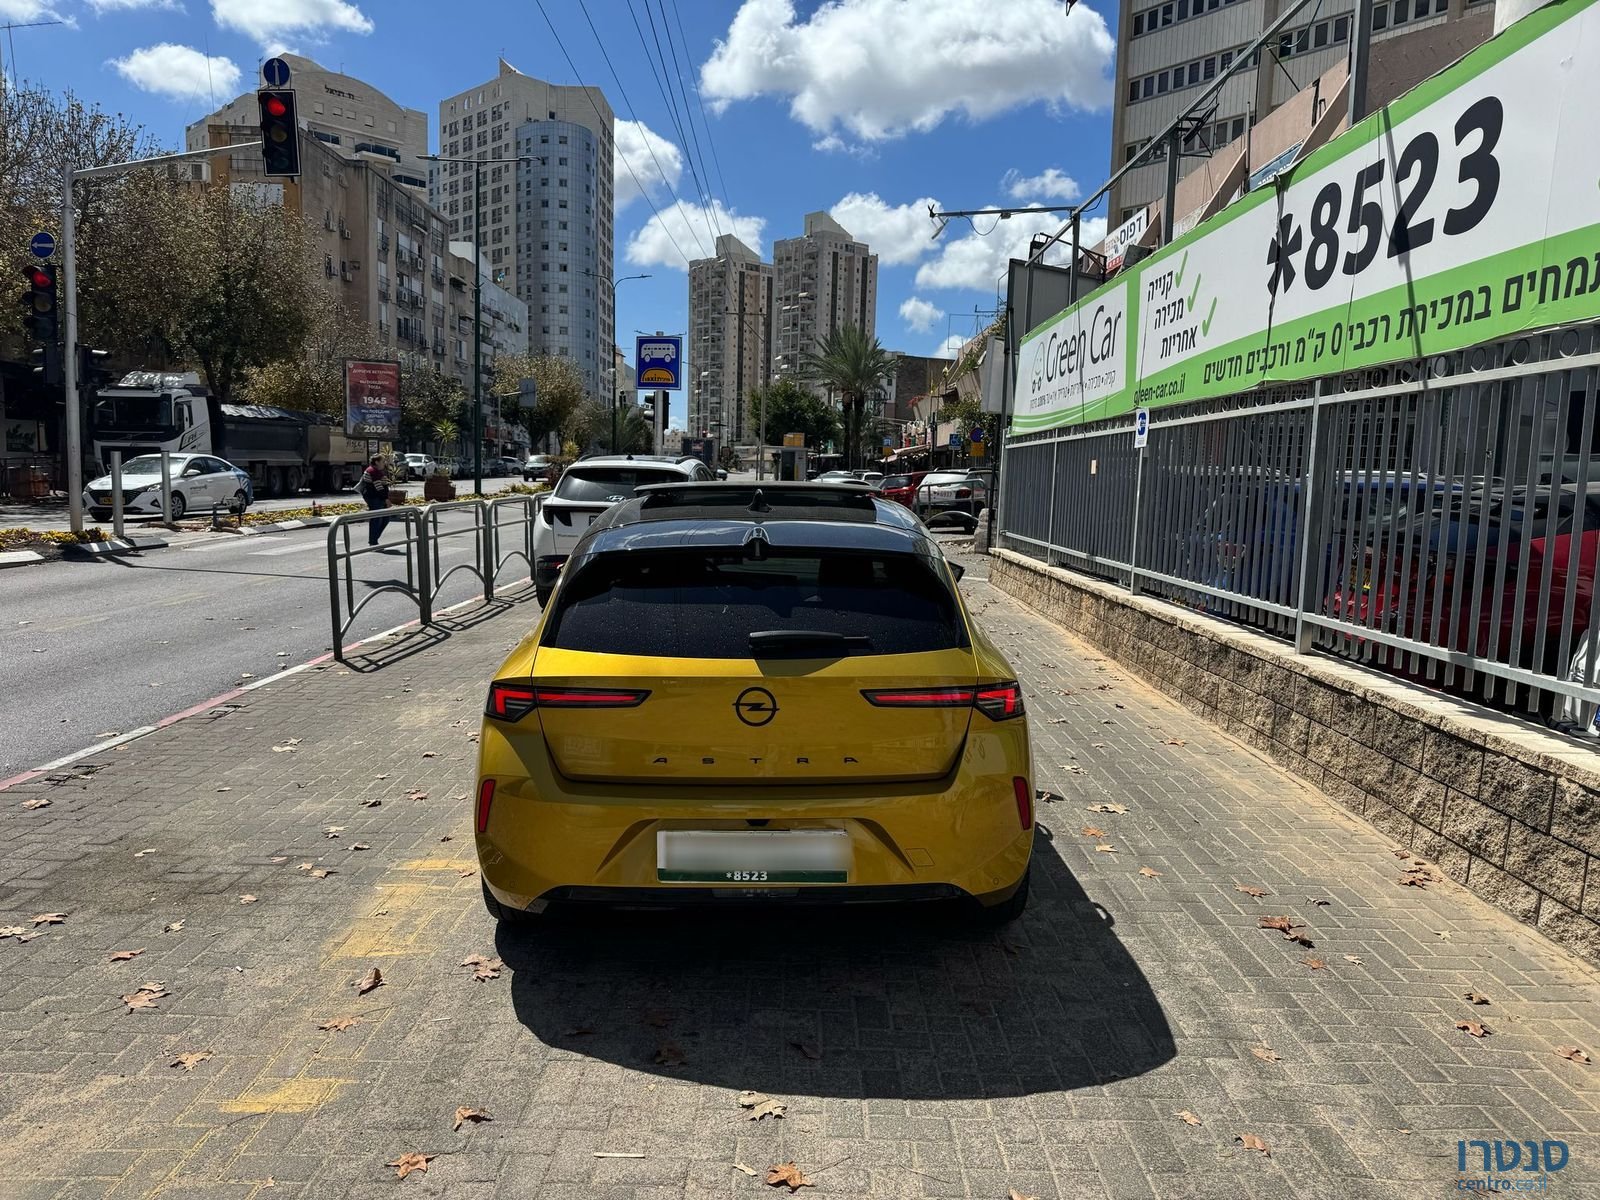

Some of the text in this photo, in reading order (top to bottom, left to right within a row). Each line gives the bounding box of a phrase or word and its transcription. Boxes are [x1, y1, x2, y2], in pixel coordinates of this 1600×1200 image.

[1120, 216, 1142, 245] דפוס
[1148, 270, 1173, 302] קנייה
[1154, 297, 1184, 330] מכירה
[1396, 285, 1492, 340] במכירת
[1046, 304, 1122, 382] Green Car
[1160, 325, 1198, 359] אחריות
[1331, 322, 1343, 356] 0
[1348, 314, 1390, 352] רכבי
[1203, 354, 1243, 384] חדשים
[1245, 341, 1291, 375] ורכבים
[363, 396, 387, 405] 1945
[1134, 373, 1186, 408] green-car.co.il
[364, 425, 389, 434] 2024
[653, 756, 859, 765] ASTRA
